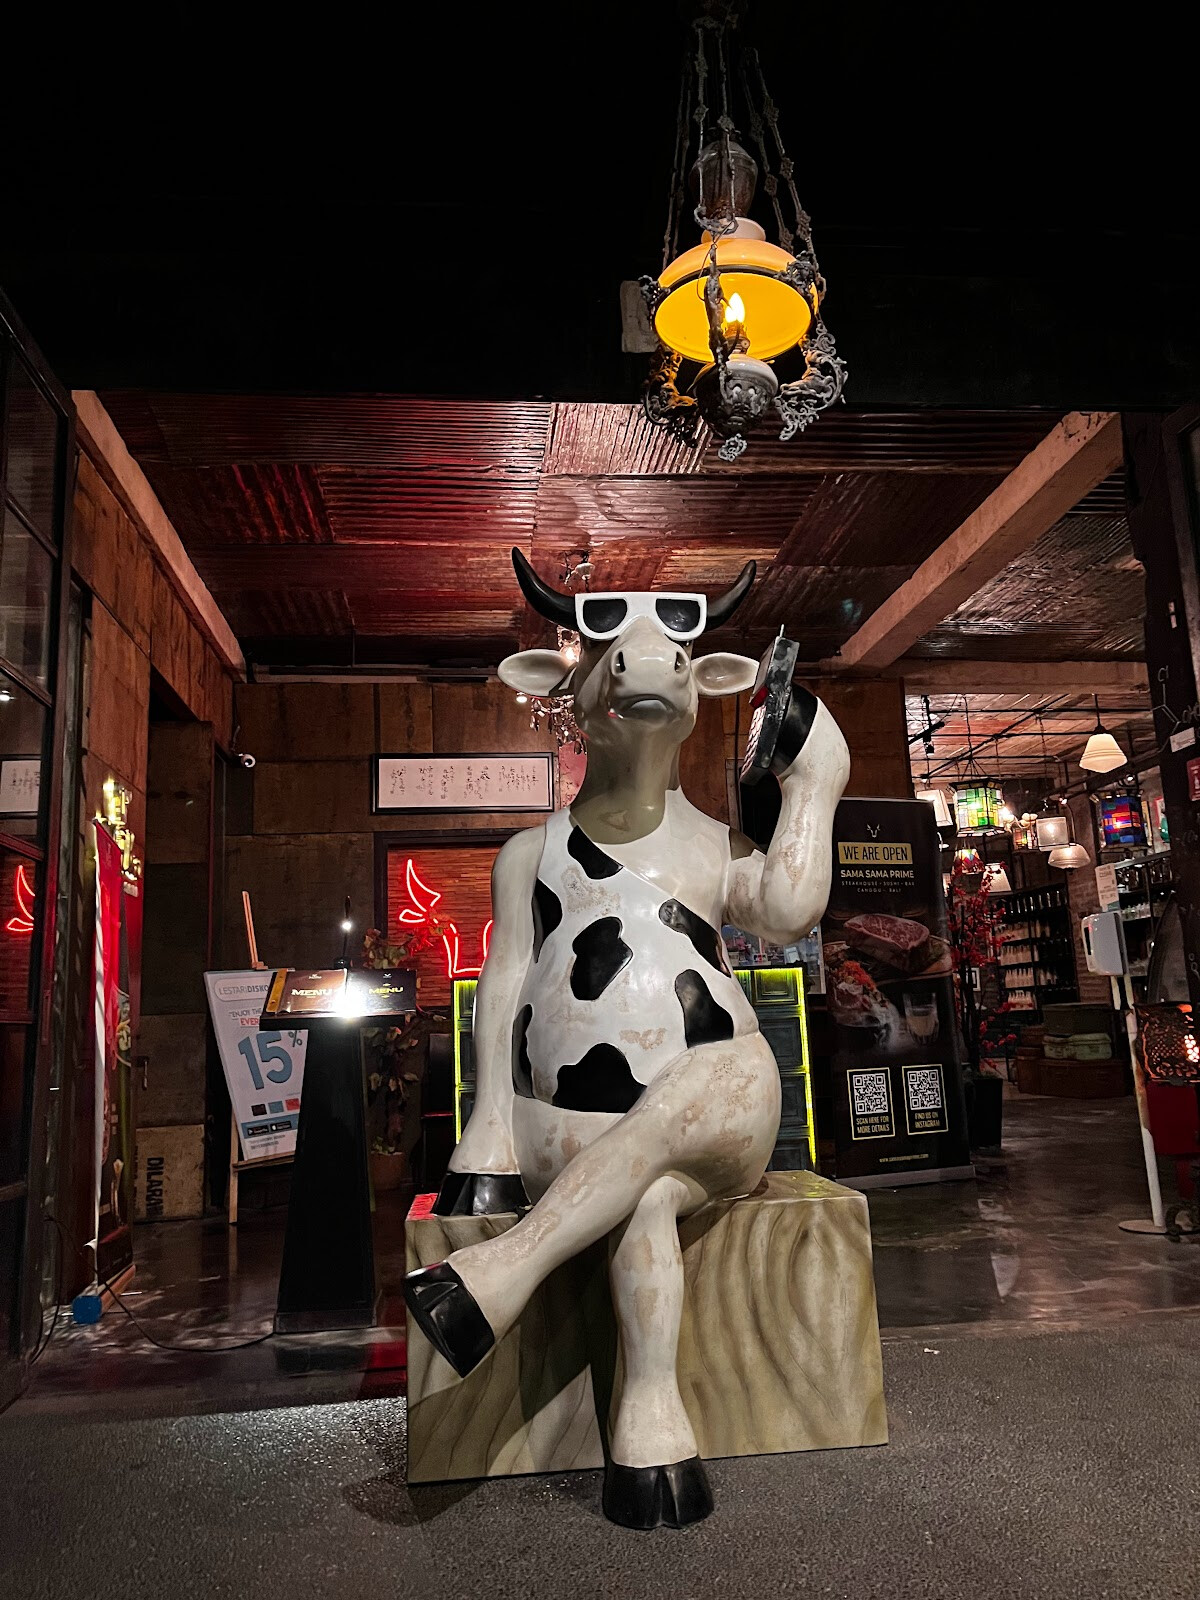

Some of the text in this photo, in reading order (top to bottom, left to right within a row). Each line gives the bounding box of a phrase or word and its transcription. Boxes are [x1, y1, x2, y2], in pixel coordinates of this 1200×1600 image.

[843, 846, 908, 861] WE ARE OPEN
[840, 869, 914, 879] SAMA SAMA PRIME
[291, 988, 333, 996] MENU
[368, 986, 404, 995] MENU
